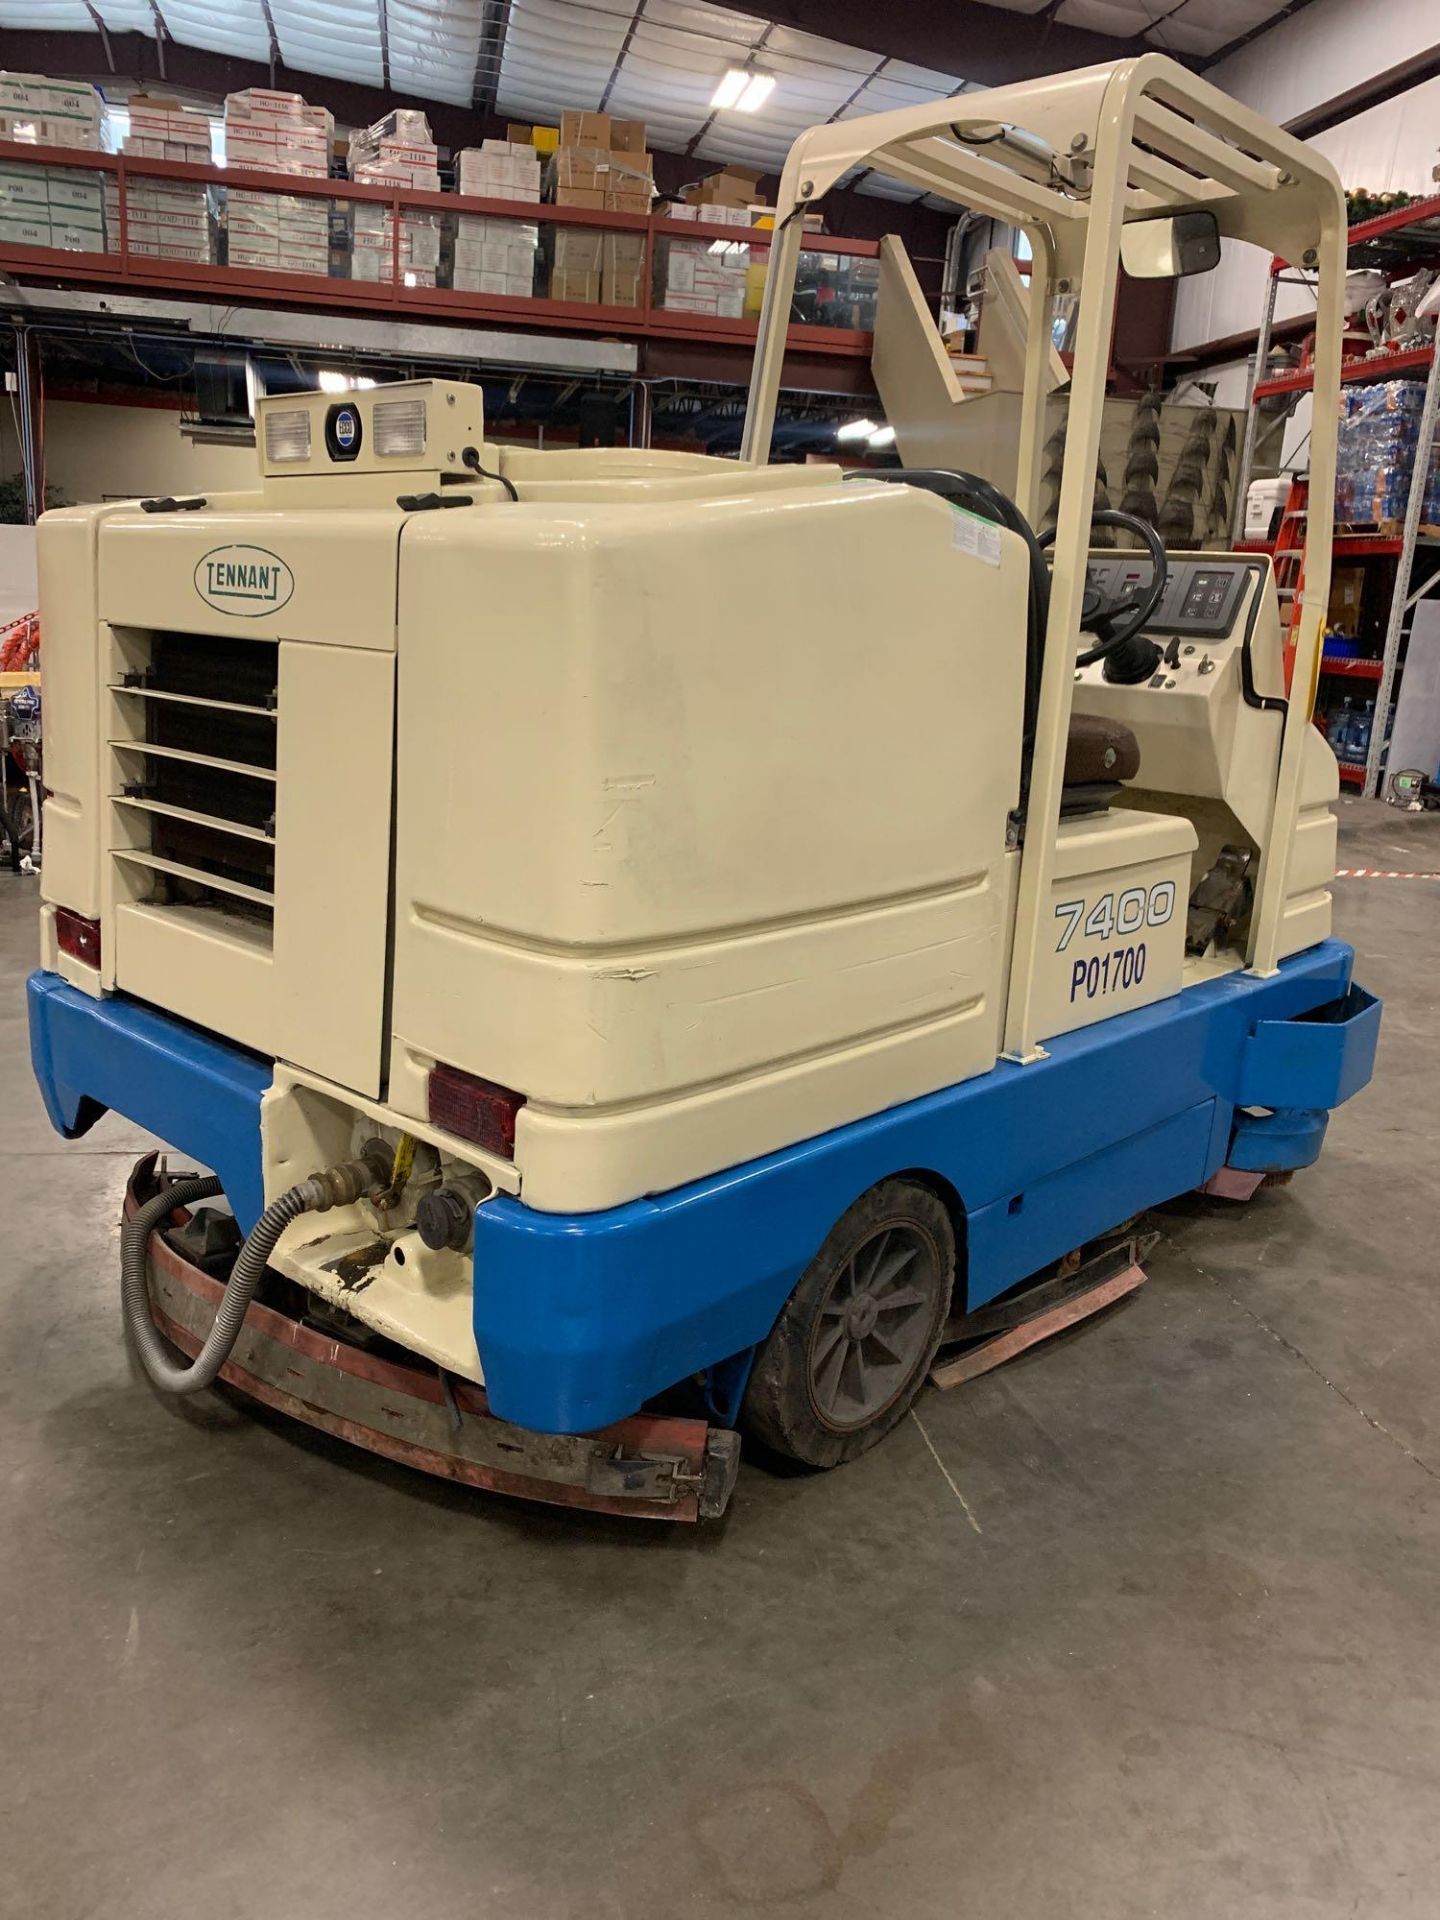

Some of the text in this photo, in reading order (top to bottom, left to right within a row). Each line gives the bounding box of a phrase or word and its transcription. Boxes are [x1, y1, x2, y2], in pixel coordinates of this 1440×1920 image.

[13, 92, 29, 102] 004
[63, 99, 80, 109] 004
[206, 562, 281, 601] TENNANT
[1054, 880, 1176, 952] 7400
[1069, 942, 1147, 1003] P01700
